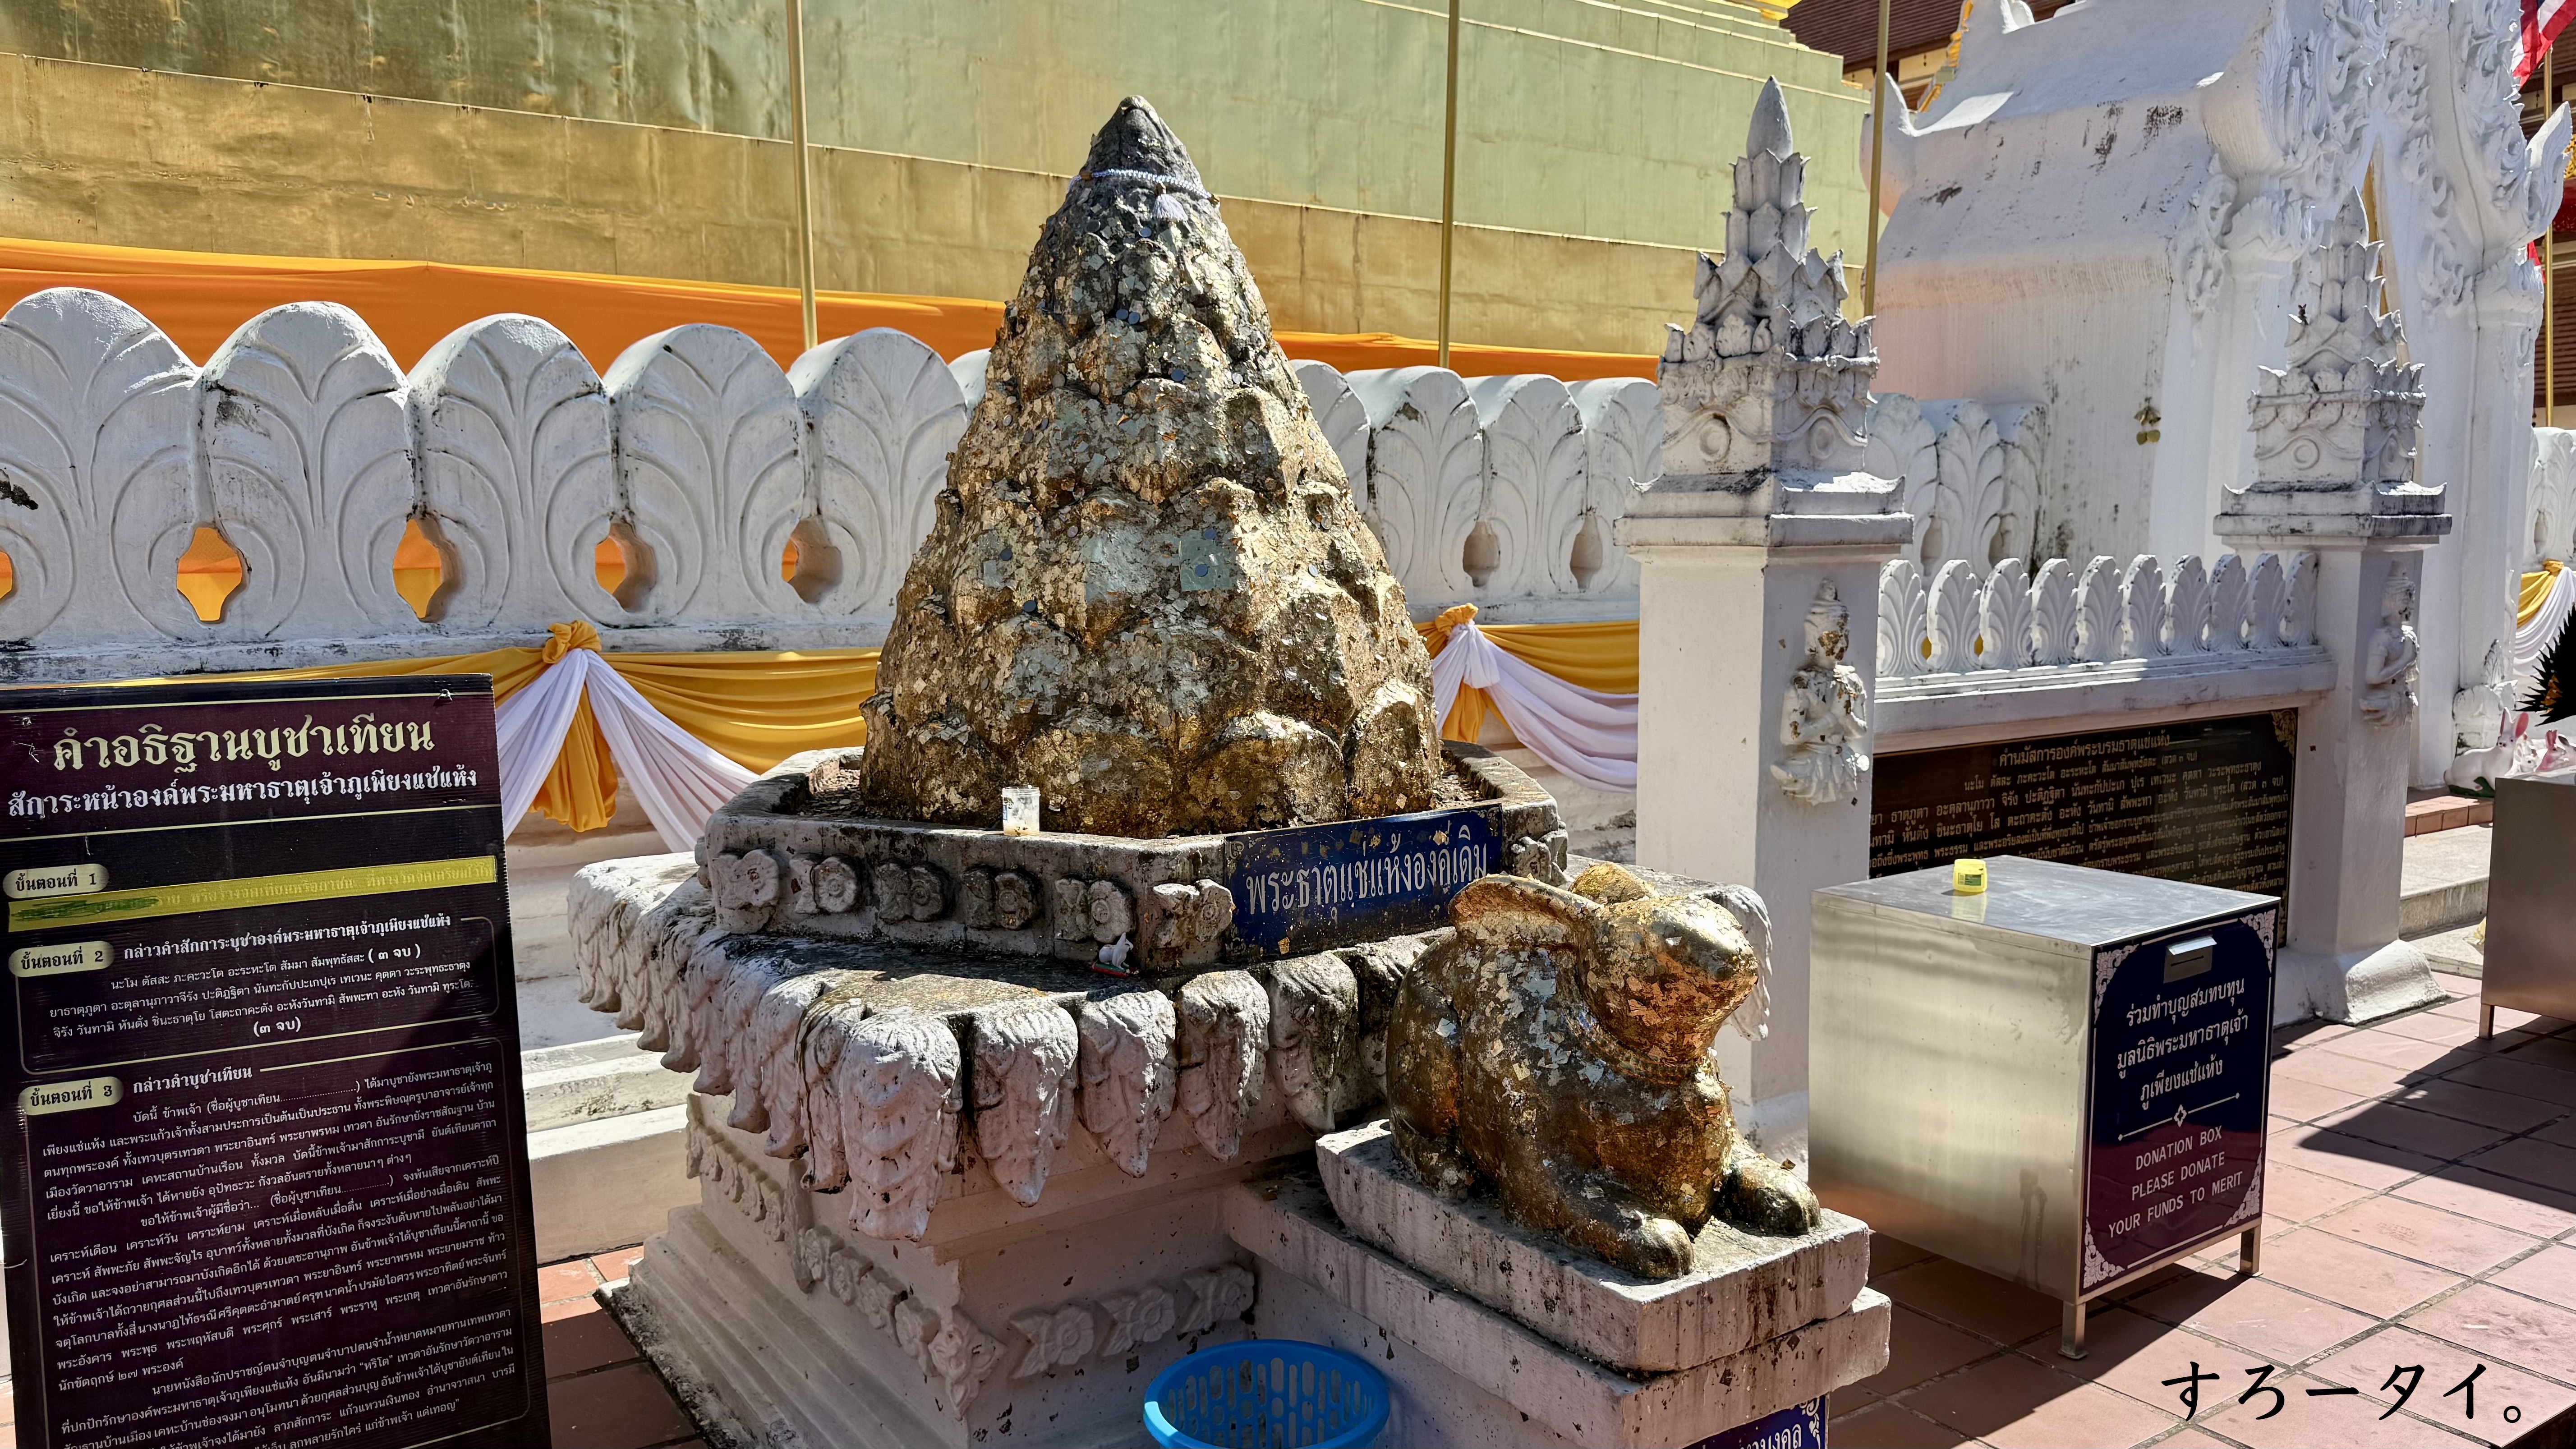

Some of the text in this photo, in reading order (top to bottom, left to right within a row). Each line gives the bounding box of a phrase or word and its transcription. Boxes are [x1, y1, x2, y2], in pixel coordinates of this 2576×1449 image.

[53, 714, 435, 773] คำอธิฐานบูชาเทียน
[16, 868, 96, 891] ขั้นตอนที่ 1
[21, 946, 103, 970] ขั้นตอนที่ 2
[110, 977, 138, 989] นะโม
[142, 975, 170, 986] ตัสสะ
[173, 967, 224, 983] ภะคะวะโต
[280, 960, 308, 976] สัมมา
[311, 953, 365, 969] สัมพุทธัสสะ
[50, 1003, 107, 1017] ยาธาตุภูตา
[202, 985, 250, 1000] ปะติฏฐิตา
[340, 973, 372, 984] เทเวนะ
[375, 970, 401, 983] คุตตา
[76, 1021, 115, 1035] วันทามิ
[208, 1002, 273, 1020] โสตะถาคะตัง
[276, 994, 337, 1012] อะหังวันทามิ
[339, 992, 379, 1004] สัพพะทา
[382, 986, 405, 998] อะหัง
[407, 981, 440, 995] วันทามิ
[2126, 978, 2245, 1026] ร่วมทำบุญสมทบทุน
[2117, 1008, 2248, 1079] มูลนิธิพระมหาธาตุเจ้า
[30, 1081, 112, 1106] ขั้นตอนที่ 3
[133, 1066, 253, 1094] กล่าวคำบูชาเทียน
[133, 1061, 492, 1122] บัดนี้ ข้าพเจ้า ได้มาบูชายังพระมหาธาตุเจ้าภู
[2140, 1053, 2223, 1110] ภูเพียงแช่แห้ง
[43, 1137, 105, 1157] เพียงแช่แห้ง
[44, 1155, 119, 1178] ตนทุกพระองค์
[122, 1146, 211, 1166] ทั้งเทวบุตรเทวดา
[214, 1132, 276, 1153] พระยาอินทร์
[279, 1126, 340, 1142] พระยาพรหม
[343, 1121, 373, 1132] เทวดา
[476, 1099, 495, 1115] บ้าน
[46, 1178, 133, 1199] เมืองวัดวาอาราม
[142, 1160, 243, 1185] เคหะสถานบ้านเรือน
[251, 1152, 285, 1168] ทั้งมวล
[431, 1114, 497, 1137] ยันต์เทียนคาถา
[2136, 1125, 2222, 1170] DONATION BOX
[403, 1154, 499, 1181] จงพ้นเสียจากเคราะห์ปี
[2132, 1152, 2225, 1201] PLEASE DONATE
[47, 1201, 80, 1220] เยี่ยงนี้
[83, 1193, 153, 1214] ขอให้ข้าพเจ้า
[156, 1186, 205, 1203] ได้หายยัง
[208, 1174, 255, 1198] อุปัทธะวะ
[50, 1243, 117, 1263] เคราะห์เดือน
[126, 1232, 179, 1251] เคราะห์วัน
[187, 1214, 245, 1241] เคราะห์ยาม
[253, 1197, 362, 1229] เคราะห์เมื่อหลับเมื่อตื่น
[476, 1176, 501, 1187] สัพพะ
[2108, 1171, 2242, 1238] YOUR FUNDS TO MERIT
[51, 1266, 91, 1284] เคราะห์
[94, 1260, 140, 1277] สัพพะภัย
[143, 1249, 202, 1269] สัพพะจัญไร
[52, 1291, 87, 1306] บังเกิด
[263, 1245, 348, 1269] ด้วยเตชะอานุภาพ
[491, 1214, 504, 1223] ขอ
[303, 1259, 362, 1281] พระยาอินทร์
[366, 1250, 423, 1269] พระยาพรหม
[427, 1236, 485, 1256] พระยายมราช
[488, 1232, 505, 1243] ท้าว
[57, 1271, 507, 1370] พระอังคาร พระพุธ พระพฤหัสบดี พระศุกร์ พระเสาร์ พระราหู พระเกตุ เทวดาอันรักษาดาว
[58, 1357, 184, 1391] นักขัตฤกษ์ ๒๗ พระองค์
[303, 1363, 356, 1385] อันมีนามว่า
[249, 1399, 299, 1418] อนุโมทนา
[274, 1363, 515, 1433] ลาภสักการะ แก้วแหวนเงินทอง อำนาจวาสนา บารมี
[365, 1410, 413, 1431] แก่ข้าพเจ้า
